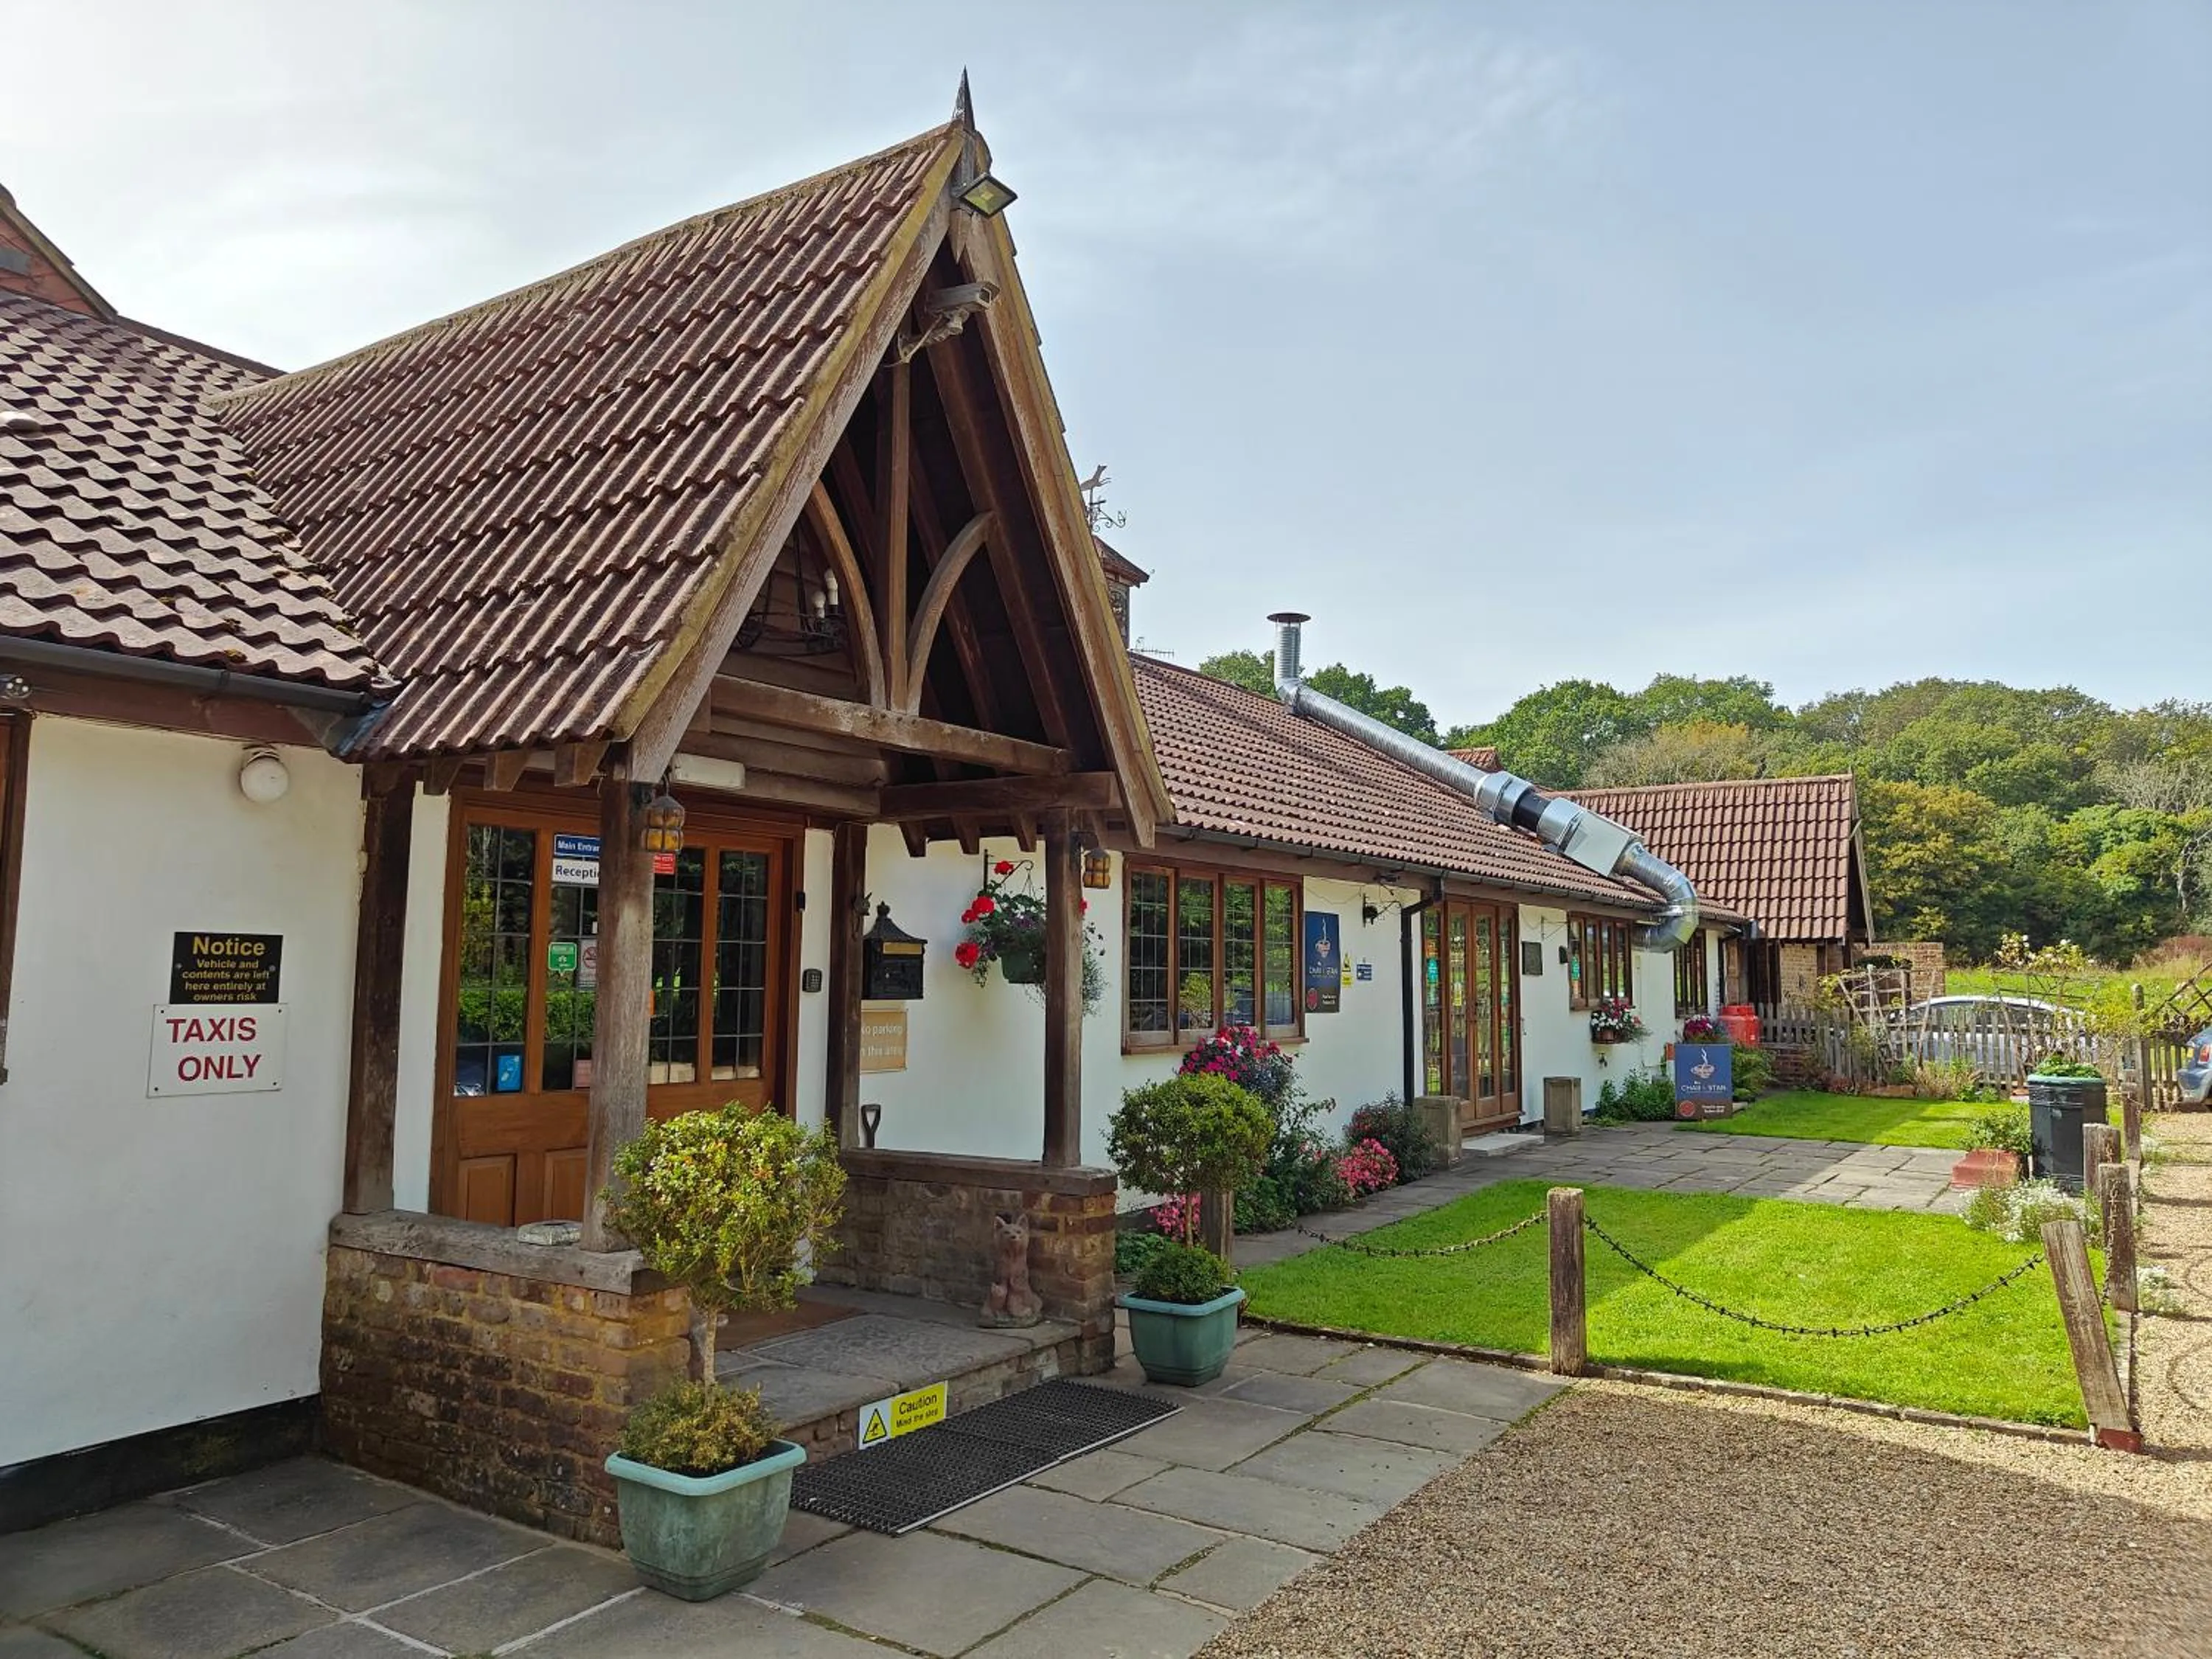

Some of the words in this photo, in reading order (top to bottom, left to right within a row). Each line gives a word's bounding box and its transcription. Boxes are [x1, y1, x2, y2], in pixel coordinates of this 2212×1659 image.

[557, 840, 576, 850] Main
[555, 865, 600, 880] Recepti
[192, 936, 266, 956] Notice
[197, 959, 236, 969] Vehicle
[238, 959, 259, 969] and
[182, 970, 231, 979] contents
[234, 971, 251, 979] are
[253, 970, 270, 979] left
[185, 981, 210, 990] here
[213, 981, 253, 992] entirely
[255, 982, 266, 990] at
[193, 993, 234, 1001] owners
[237, 992, 257, 1001] risk
[166, 1017, 257, 1043] TAXIS
[177, 1054, 262, 1082] ONLY
[899, 1394, 938, 1414] Caution
[896, 1416, 912, 1427] Mind
[914, 1413, 924, 1422] the
